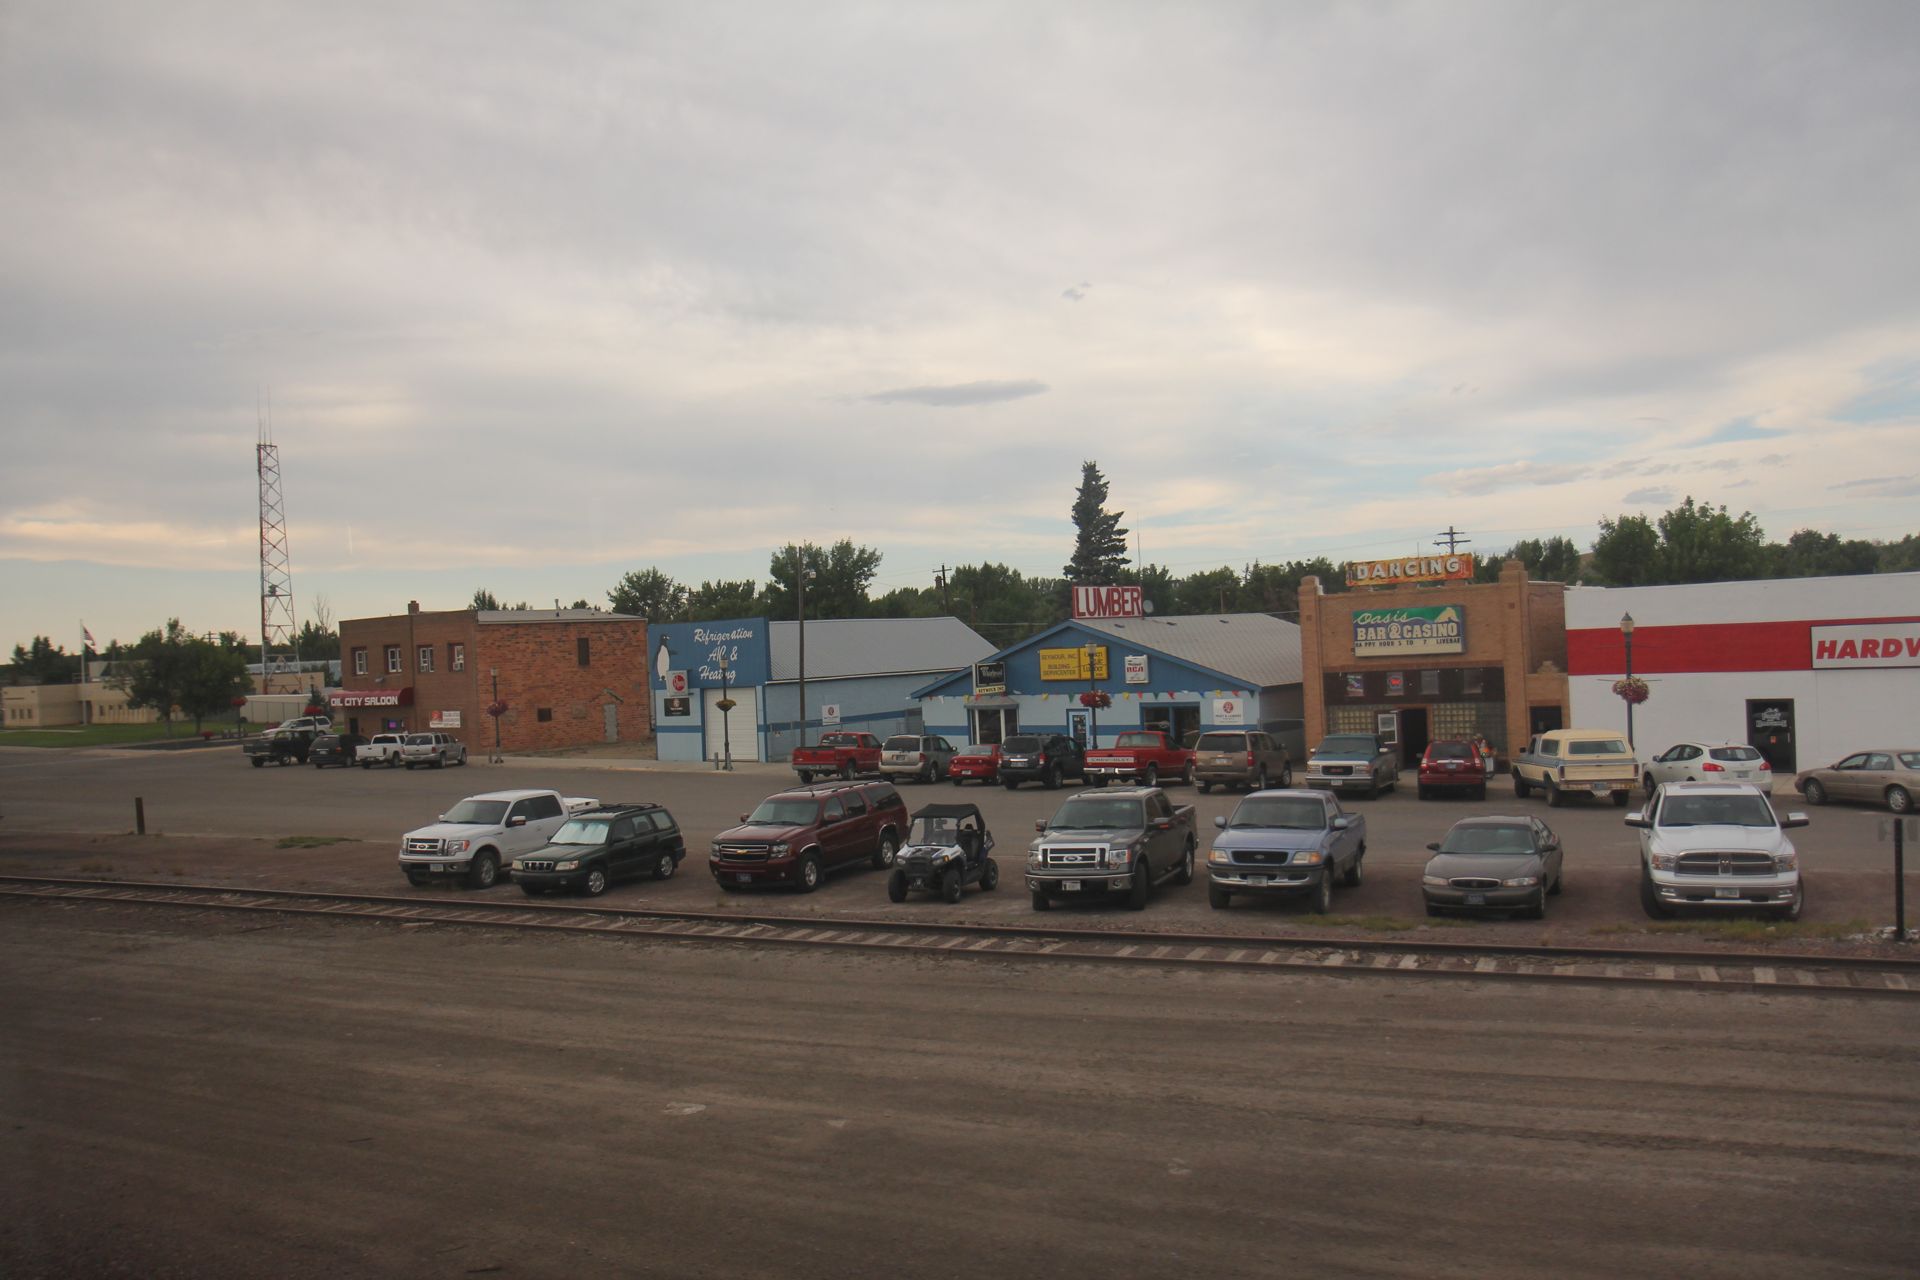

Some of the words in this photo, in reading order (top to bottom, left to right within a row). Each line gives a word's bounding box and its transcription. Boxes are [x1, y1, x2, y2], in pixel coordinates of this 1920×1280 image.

[1357, 557, 1460, 580] DANCING
[1074, 587, 1141, 616] LUMBER
[1353, 610, 1409, 625] Oasis
[694, 628, 753, 645] Refrigeration
[1356, 626, 1386, 640] BAR
[1388, 622, 1401, 639] &
[1402, 622, 1458, 638] CASINO
[730, 645, 738, 661] &
[699, 665, 737, 685] Heatng
[330, 697, 343, 707] OIL
[344, 696, 362, 706] CITY
[364, 695, 399, 705] SALOON
